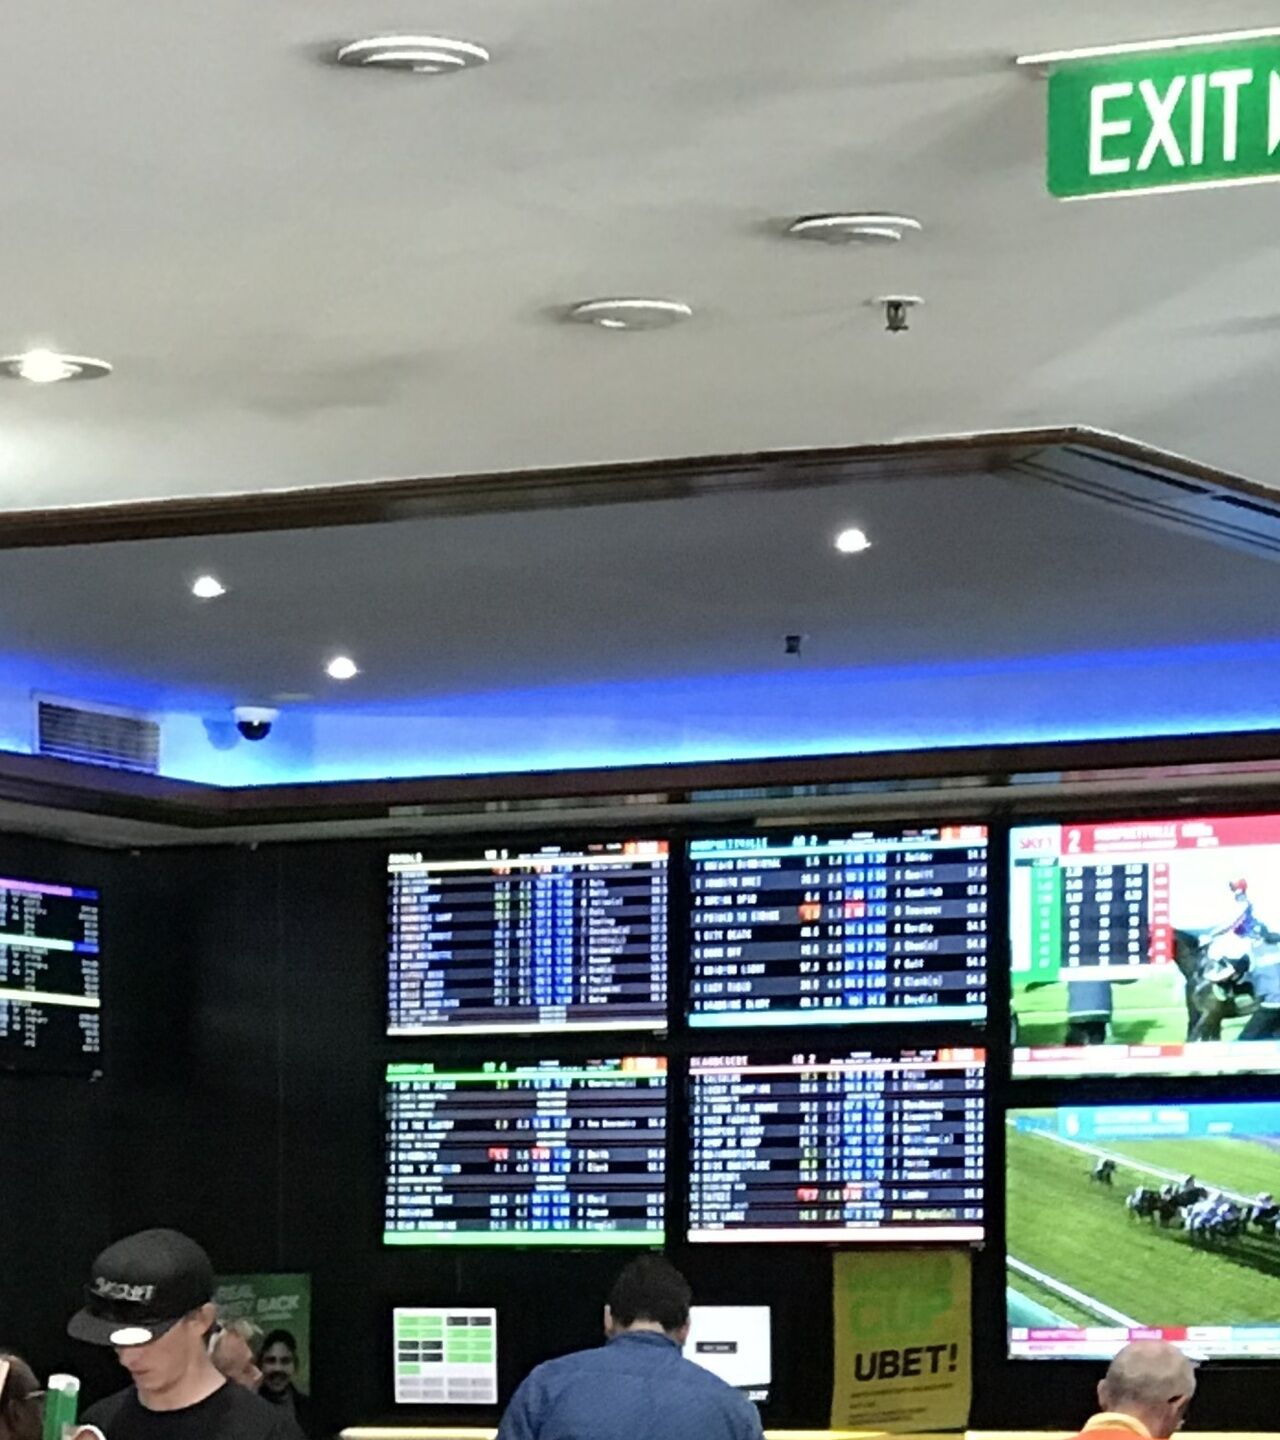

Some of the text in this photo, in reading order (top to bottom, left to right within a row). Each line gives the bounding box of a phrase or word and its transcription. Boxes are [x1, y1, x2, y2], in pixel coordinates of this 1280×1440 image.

[1088, 68, 1253, 175] EXIT
[257, 1295, 300, 1313] BACK
[853, 1343, 959, 1382] UBET!
